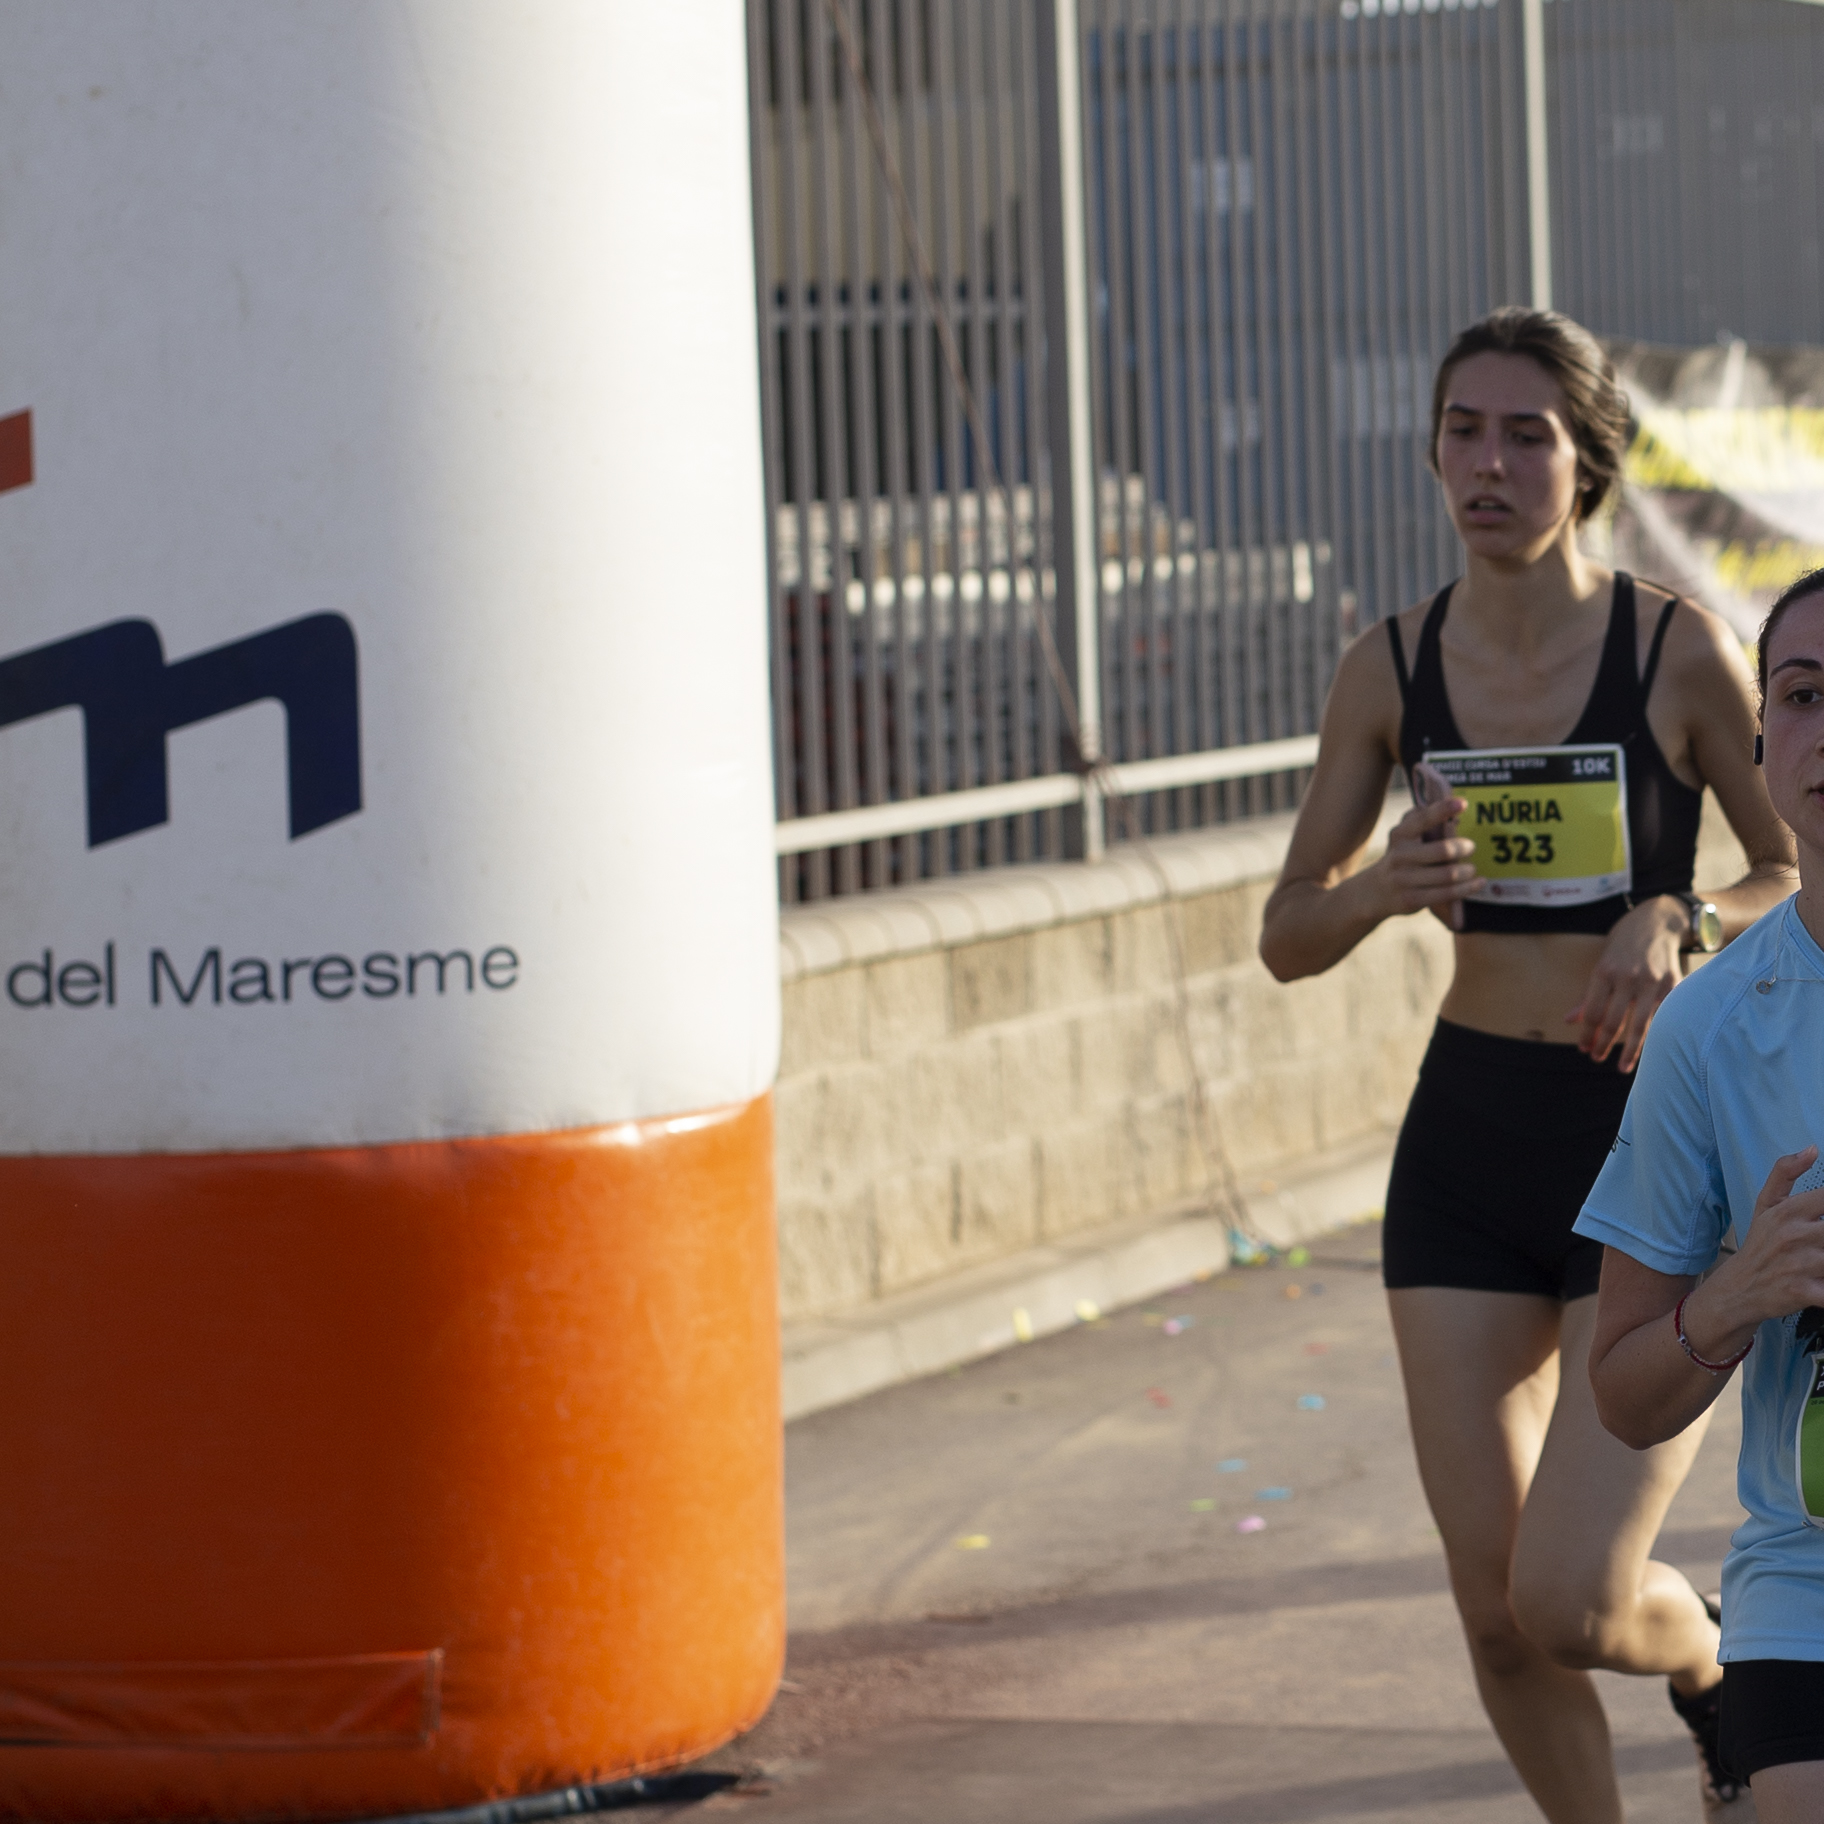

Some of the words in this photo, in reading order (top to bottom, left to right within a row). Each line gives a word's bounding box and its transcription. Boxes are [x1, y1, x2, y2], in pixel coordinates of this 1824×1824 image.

[1571, 757, 1612, 776] 10K
[1476, 794, 1562, 825] NÚRIA
[1491, 833, 1554, 864] 323
[6, 941, 115, 1008] del
[150, 944, 520, 1007] Maresme
